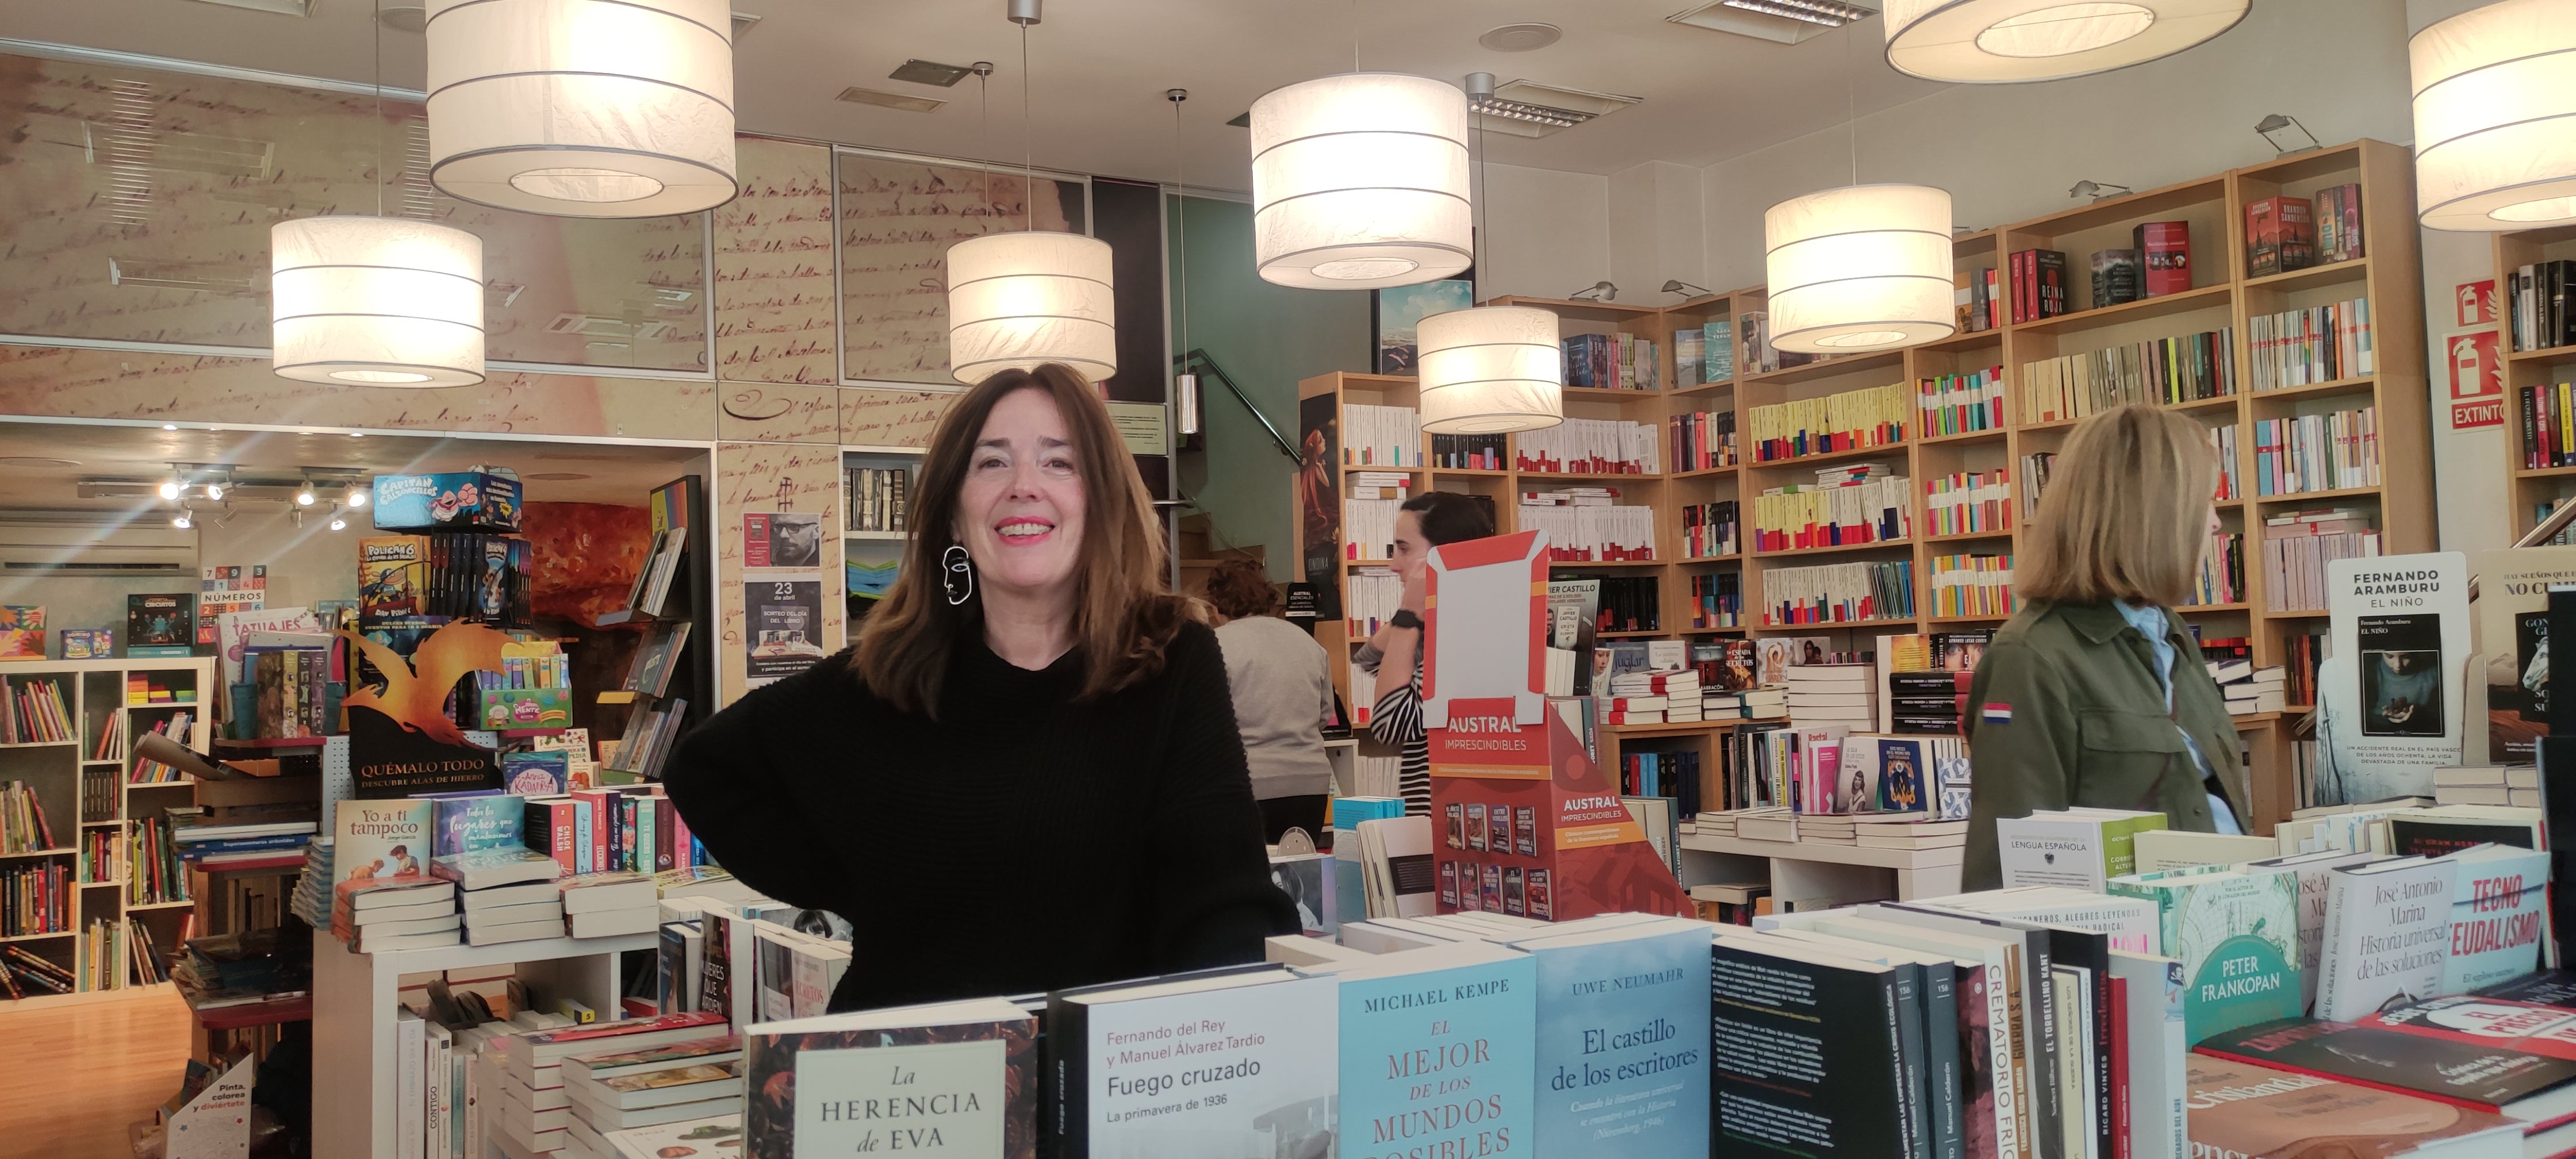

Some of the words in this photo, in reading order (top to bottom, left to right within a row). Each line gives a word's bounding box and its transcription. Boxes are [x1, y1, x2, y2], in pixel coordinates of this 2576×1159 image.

[2042, 285, 2064, 300] REINA
[2044, 299, 2063, 313] ROJA
[380, 477, 434, 495] CAPITÁN
[379, 487, 438, 506] CALZONCILLOS
[367, 543, 405, 555] POLICÁN
[406, 544, 415, 554] 6
[231, 569, 238, 577] 9
[1308, 556, 1329, 571] ONDINA
[2353, 570, 2439, 584] FERNANDO
[2520, 571, 2552, 580] SUEÑOS
[205, 593, 262, 602] NÚMEROS
[775, 582, 793, 594] 23
[1562, 584, 1596, 593] CASTILLO
[2354, 582, 2440, 596] ARAMBURU
[2504, 582, 2528, 596] NO
[204, 607, 210, 615] 2
[2371, 599, 2386, 608] EL
[2390, 596, 2424, 607] NIÑO
[1613, 650, 1644, 673] juglar
[515, 706, 540, 715] MENTE
[1448, 716, 1522, 733] AUSTRAL
[1444, 739, 1527, 751] IMPRESCINDIBLES
[361, 761, 438, 778] QUÉMALO
[440, 759, 485, 772] TODO
[361, 778, 409, 788] DESCUBRE
[410, 777, 434, 785] ALAS
[450, 774, 484, 782] HIERRO
[466, 807, 484, 818] Todos
[485, 805, 494, 815] los
[1563, 796, 1619, 811] AUSTRAL
[362, 809, 379, 823] Yo
[384, 812, 392, 822] a
[397, 809, 407, 822] ti
[1561, 810, 1622, 822] IMPRESCINDIBLES
[350, 822, 419, 839] tampoco
[450, 815, 496, 837] lugares
[499, 819, 513, 828] que
[556, 826, 564, 852] WALSH
[563, 825, 571, 851] CHLOE
[2011, 841, 2043, 849] LENGUA
[2044, 841, 2087, 851] ESPAÑOLA
[2374, 881, 2399, 907] José
[2399, 876, 2443, 901] Antonio
[2472, 874, 2523, 914] TECNO
[2065, 911, 2099, 922] ALEGRES
[2102, 908, 2141, 919] LEYENDAS
[2389, 904, 2426, 927] Marina
[2092, 923, 2125, 932] RADICAL
[2448, 909, 2540, 956] EUDALISMO
[2359, 931, 2402, 956] Historia
[2404, 919, 2447, 946] universal
[2040, 953, 2049, 979] KANT
[2222, 955, 2259, 978] PETER
[2357, 959, 2373, 981] de
[2375, 957, 2390, 977] las
[2391, 949, 2443, 974] soluciones
[703, 978, 718, 995] QUE
[1572, 980, 1608, 996] UWE
[1612, 967, 1685, 990] NEUMAHR
[2201, 972, 2280, 1003] FRANKOPAN
[1364, 989, 1448, 1014] MICHAEL
[1455, 978, 1509, 1000] KEMPE
[1885, 984, 1896, 1026] ECOLÓGICA
[2042, 981, 2053, 1038] TORBELLINO
[1106, 1027, 1172, 1047] Fernando
[1176, 1022, 1197, 1037] del
[1201, 1019, 1226, 1036] Rey
[1431, 1020, 1451, 1036] EL
[1581, 1028, 1607, 1056] El
[1611, 1017, 1676, 1050] castillo
[1989, 965, 2011, 1109] CREMATORIO
[1890, 1026, 1898, 1051] CRISIS
[2045, 1039, 2054, 1053] EL
[1106, 1054, 1115, 1069] y
[1120, 1044, 1171, 1065] Manuel
[1174, 1040, 1224, 1058] Álvarez
[1386, 1038, 1490, 1080] MEJOR
[1893, 1051, 1900, 1062] LA
[891, 1065, 915, 1086] La
[1107, 1071, 1174, 1097] Fuego
[1181, 1057, 1261, 1090] cruzado
[1551, 1066, 1577, 1091] de
[1584, 1062, 1611, 1087] los
[1616, 1047, 1699, 1082] escritores
[219, 1084, 246, 1092] Pinta,
[1409, 1083, 1432, 1101] DE
[1438, 1076, 1471, 1095] LOS
[1894, 1062, 1904, 1103] EMPRESAS
[1907, 1065, 1915, 1104] Calderón
[200, 1100, 246, 1111] diviértete
[212, 1092, 246, 1101] colorea
[430, 1085, 438, 1130] CONTIGO
[821, 1092, 982, 1123] HERENCIA
[1106, 1110, 1121, 1123] La
[1124, 1101, 1183, 1123] primavera
[1186, 1097, 1199, 1111] de
[1203, 1093, 1228, 1108] 1936
[1898, 1103, 1907, 1118] LAS
[1372, 1093, 1501, 1145] MUNDOS
[1910, 1105, 1918, 1138] Manuel
[1945, 1102, 1953, 1135] Manuel
[857, 1131, 880, 1154] de
[890, 1126, 945, 1151] EVA
